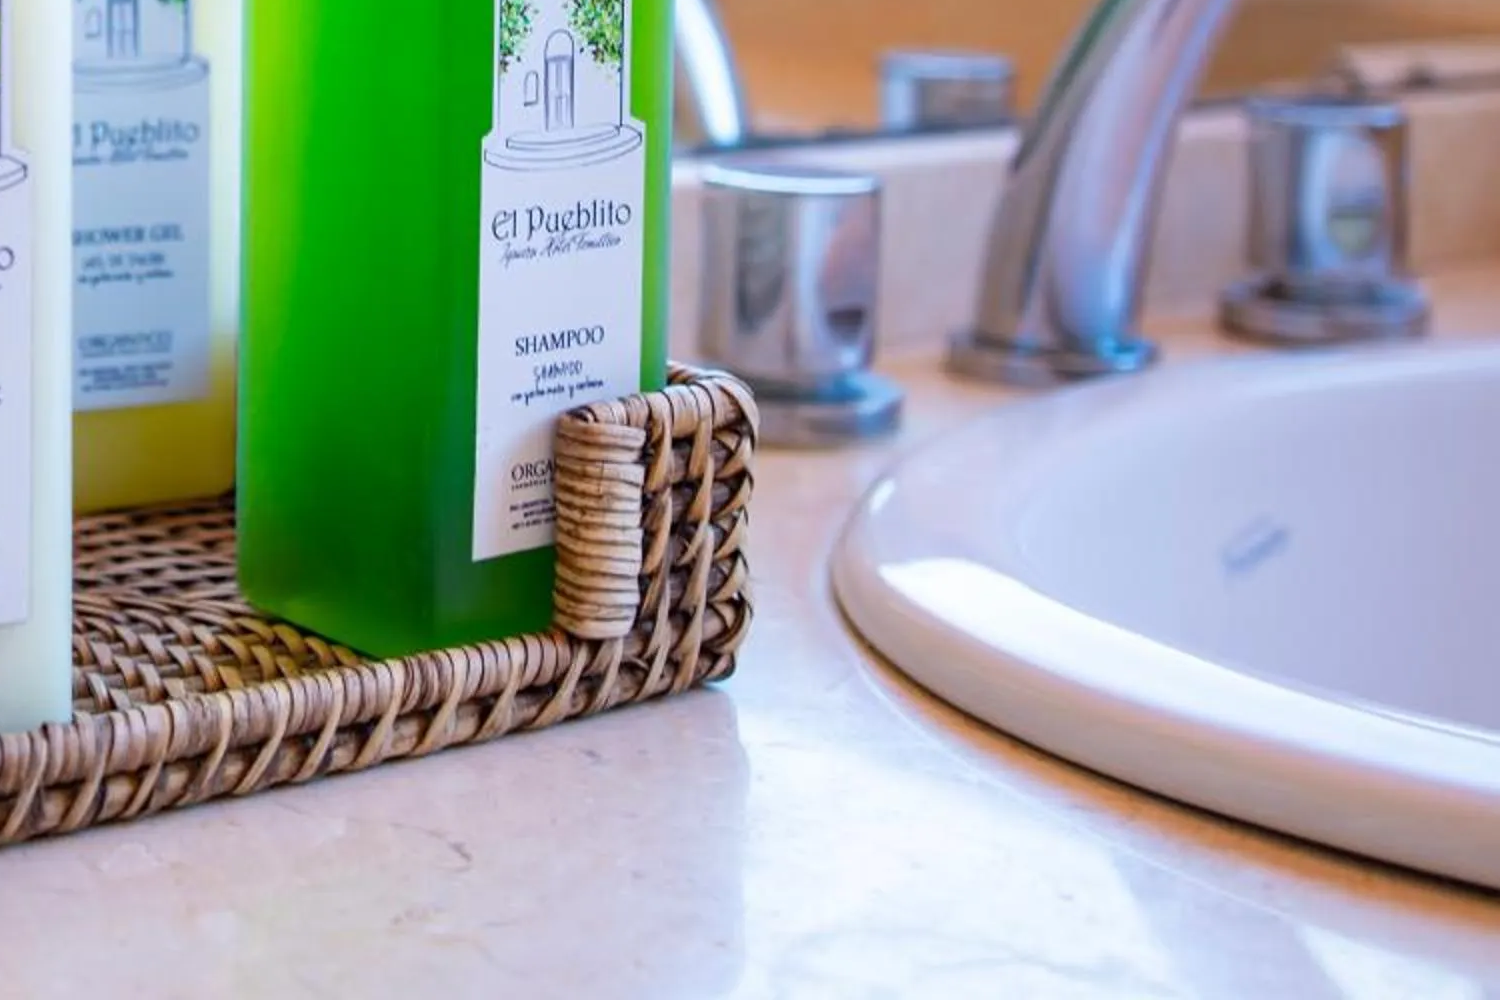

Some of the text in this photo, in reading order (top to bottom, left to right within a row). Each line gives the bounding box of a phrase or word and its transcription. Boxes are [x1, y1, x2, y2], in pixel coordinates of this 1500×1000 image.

[492, 199, 632, 242] El Pueblito
[515, 324, 605, 357] SHAMPOO
